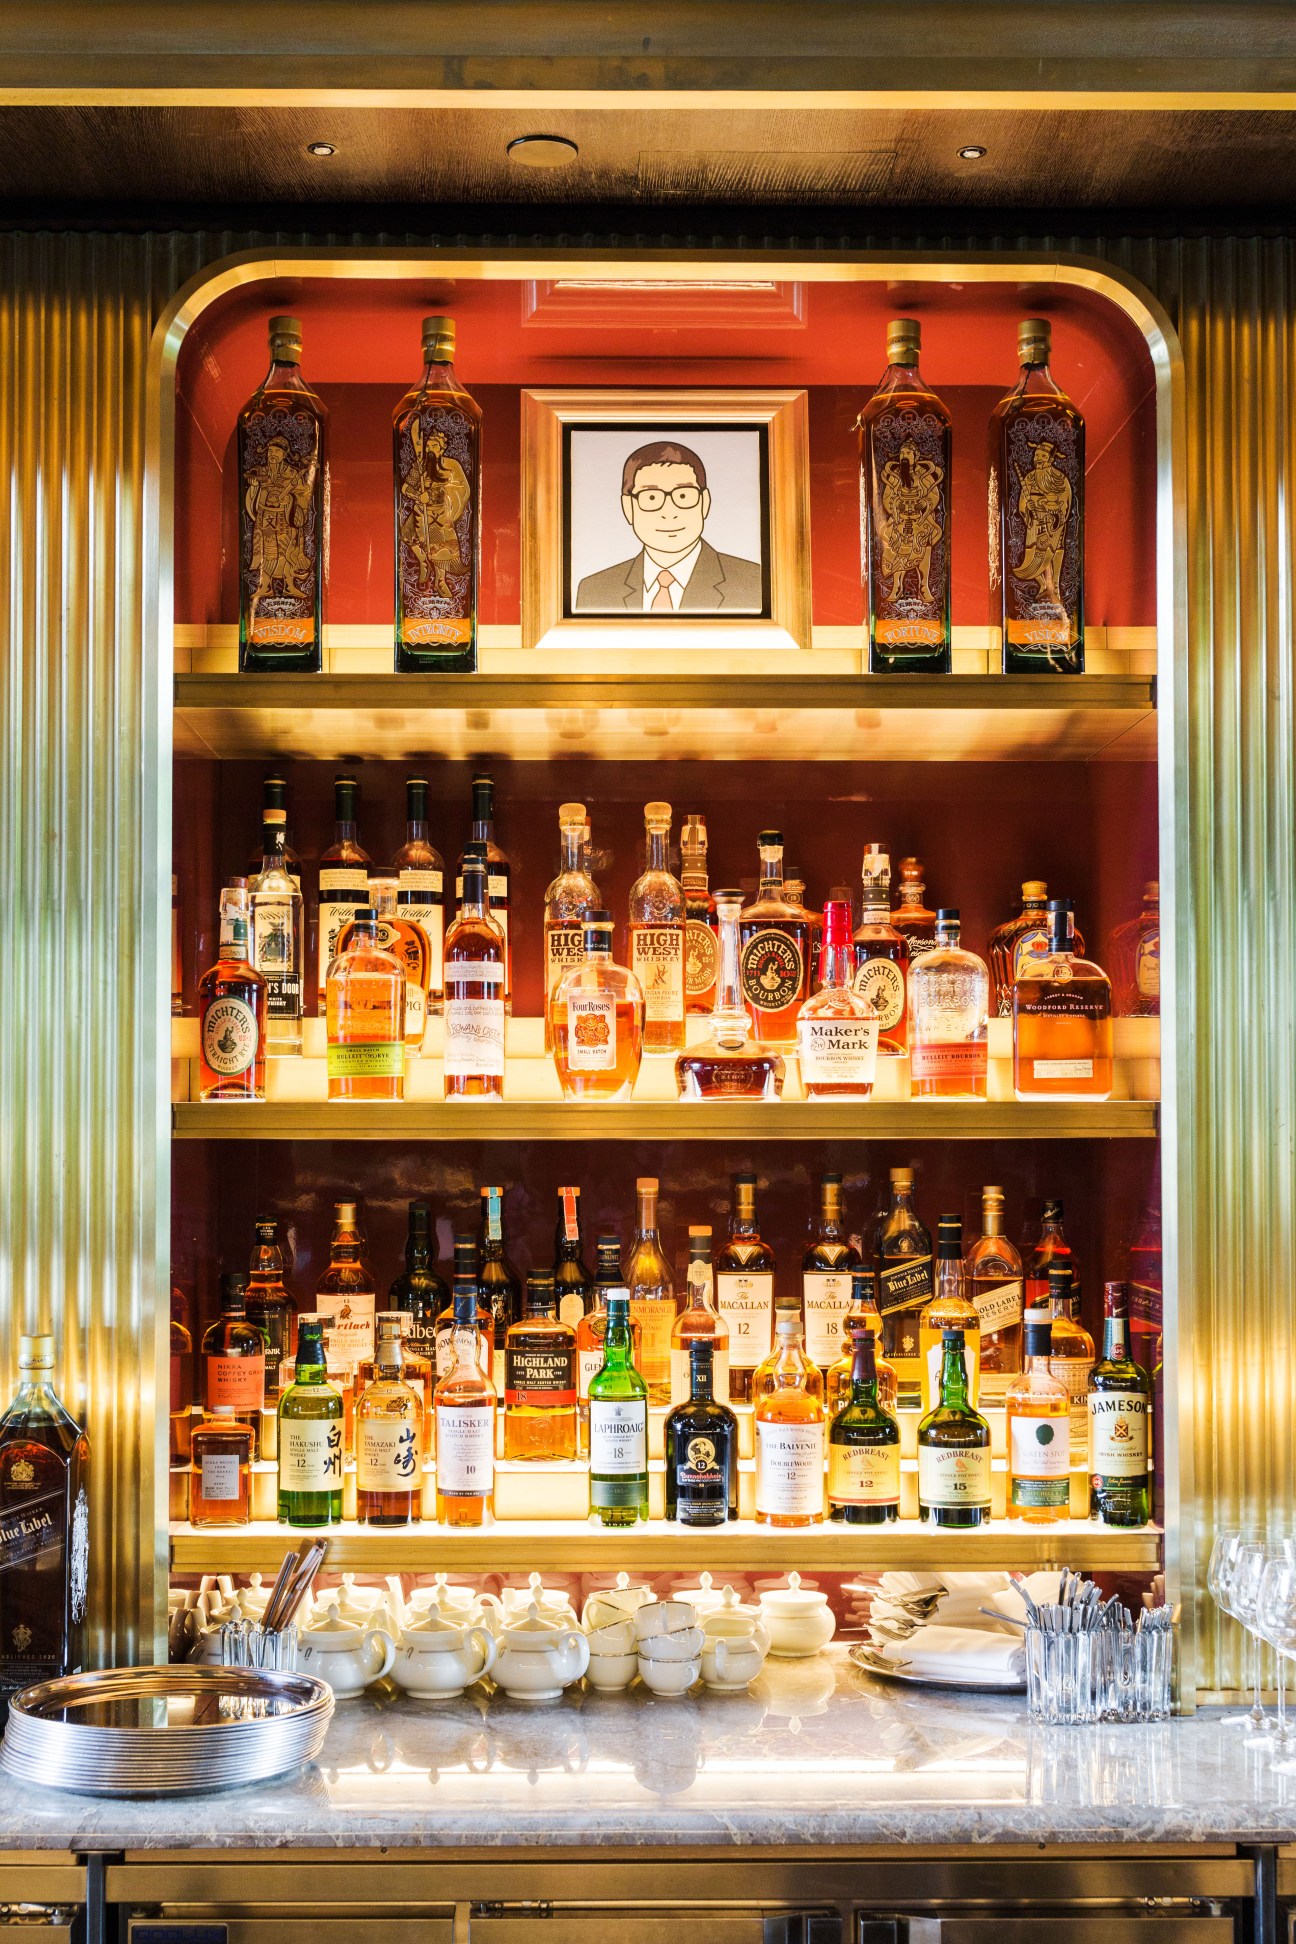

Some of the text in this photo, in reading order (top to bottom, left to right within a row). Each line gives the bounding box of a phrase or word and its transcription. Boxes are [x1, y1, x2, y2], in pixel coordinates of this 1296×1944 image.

[255, 625, 307, 640] WISDOM
[407, 624, 463, 641] INTEGRITY
[884, 626, 940, 642] FORTUNE
[1024, 629, 1070, 641] VISION
[400, 908, 432, 918] Willett
[550, 934, 583, 948] HIG
[636, 933, 680, 947] HIGH
[686, 930, 714, 955] HTER'S
[550, 948, 583, 957] WES
[636, 947, 680, 956] WEST
[748, 940, 795, 970] MICHTER'S
[859, 966, 900, 992] MICHTER'S
[282, 982, 299, 995] DOOR
[749, 980, 793, 1001] BOURBON
[879, 1002, 899, 1021] RBON
[208, 1006, 251, 1034] MICHTER'S
[811, 1027, 870, 1037] Maker's
[827, 1040, 869, 1050] Mark
[207, 1043, 250, 1065] STRAIGHT RYE
[887, 1270, 929, 1292] Blue Label
[720, 1301, 769, 1310] MACALLAN
[807, 1301, 850, 1309] MACALLA
[978, 1304, 995, 1314] OLD
[980, 1302, 1022, 1320] RESERVE
[738, 1323, 750, 1335] 12
[826, 1322, 838, 1335] 18
[513, 1355, 568, 1367] HIGHLAND
[526, 1368, 554, 1379] PARK
[517, 1392, 527, 1401] 18
[1092, 1400, 1147, 1416] JAMESON
[441, 1417, 489, 1428] TALISKER
[594, 1423, 643, 1434] LAPHROAIG
[324, 1425, 342, 1478] 白州
[614, 1448, 624, 1458] 18
[843, 1448, 889, 1461] REDBREAST
[936, 1451, 983, 1463] REDBREAST
[296, 1460, 306, 1468] 12
[370, 1458, 378, 1466] 12
[466, 1465, 476, 1474] 10
[787, 1472, 796, 1480] 12
[860, 1480, 874, 1488] 12
[953, 1483, 967, 1491] 15
[19, 1513, 53, 1536] Label
